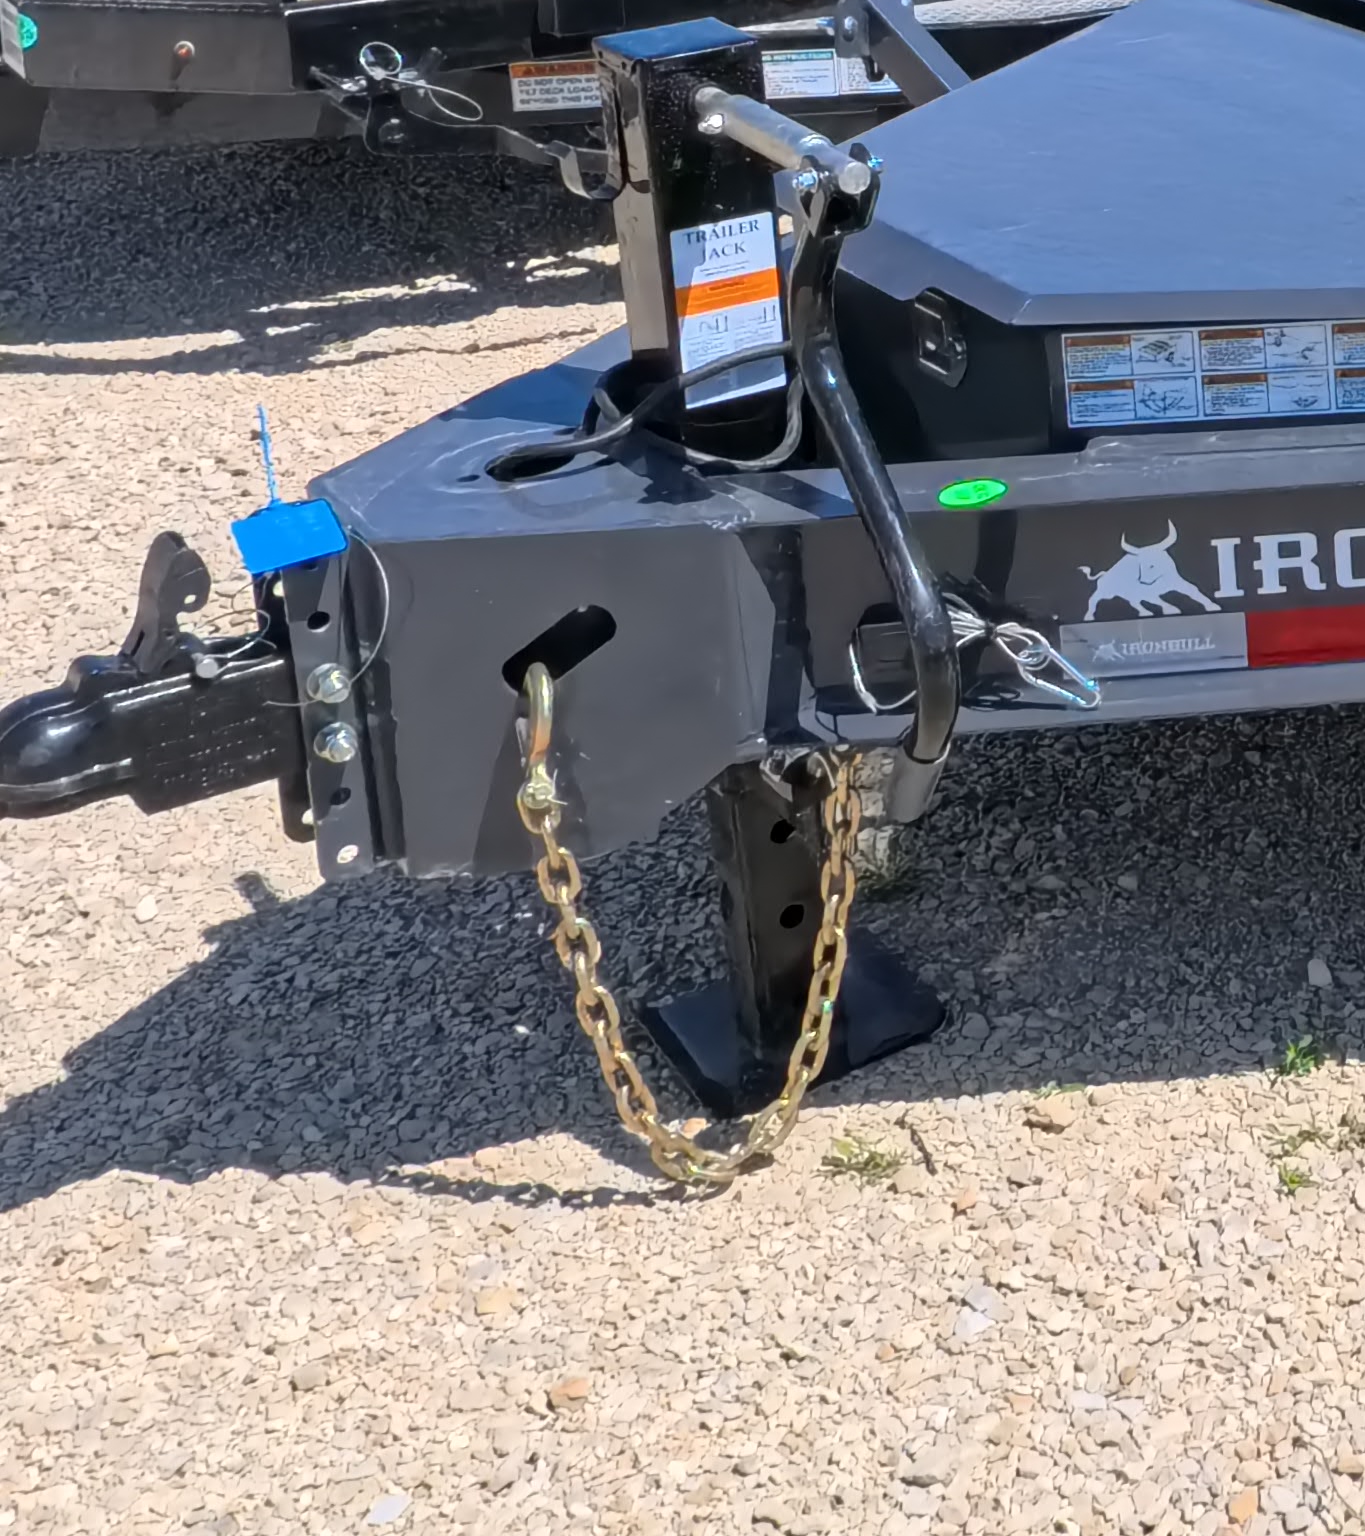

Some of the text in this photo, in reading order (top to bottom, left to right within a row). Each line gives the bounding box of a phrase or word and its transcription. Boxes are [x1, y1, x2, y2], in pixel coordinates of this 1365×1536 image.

[684, 219, 760, 245] TRAILER
[702, 241, 746, 265] JACK
[1121, 637, 1216, 656] IRONBULL
